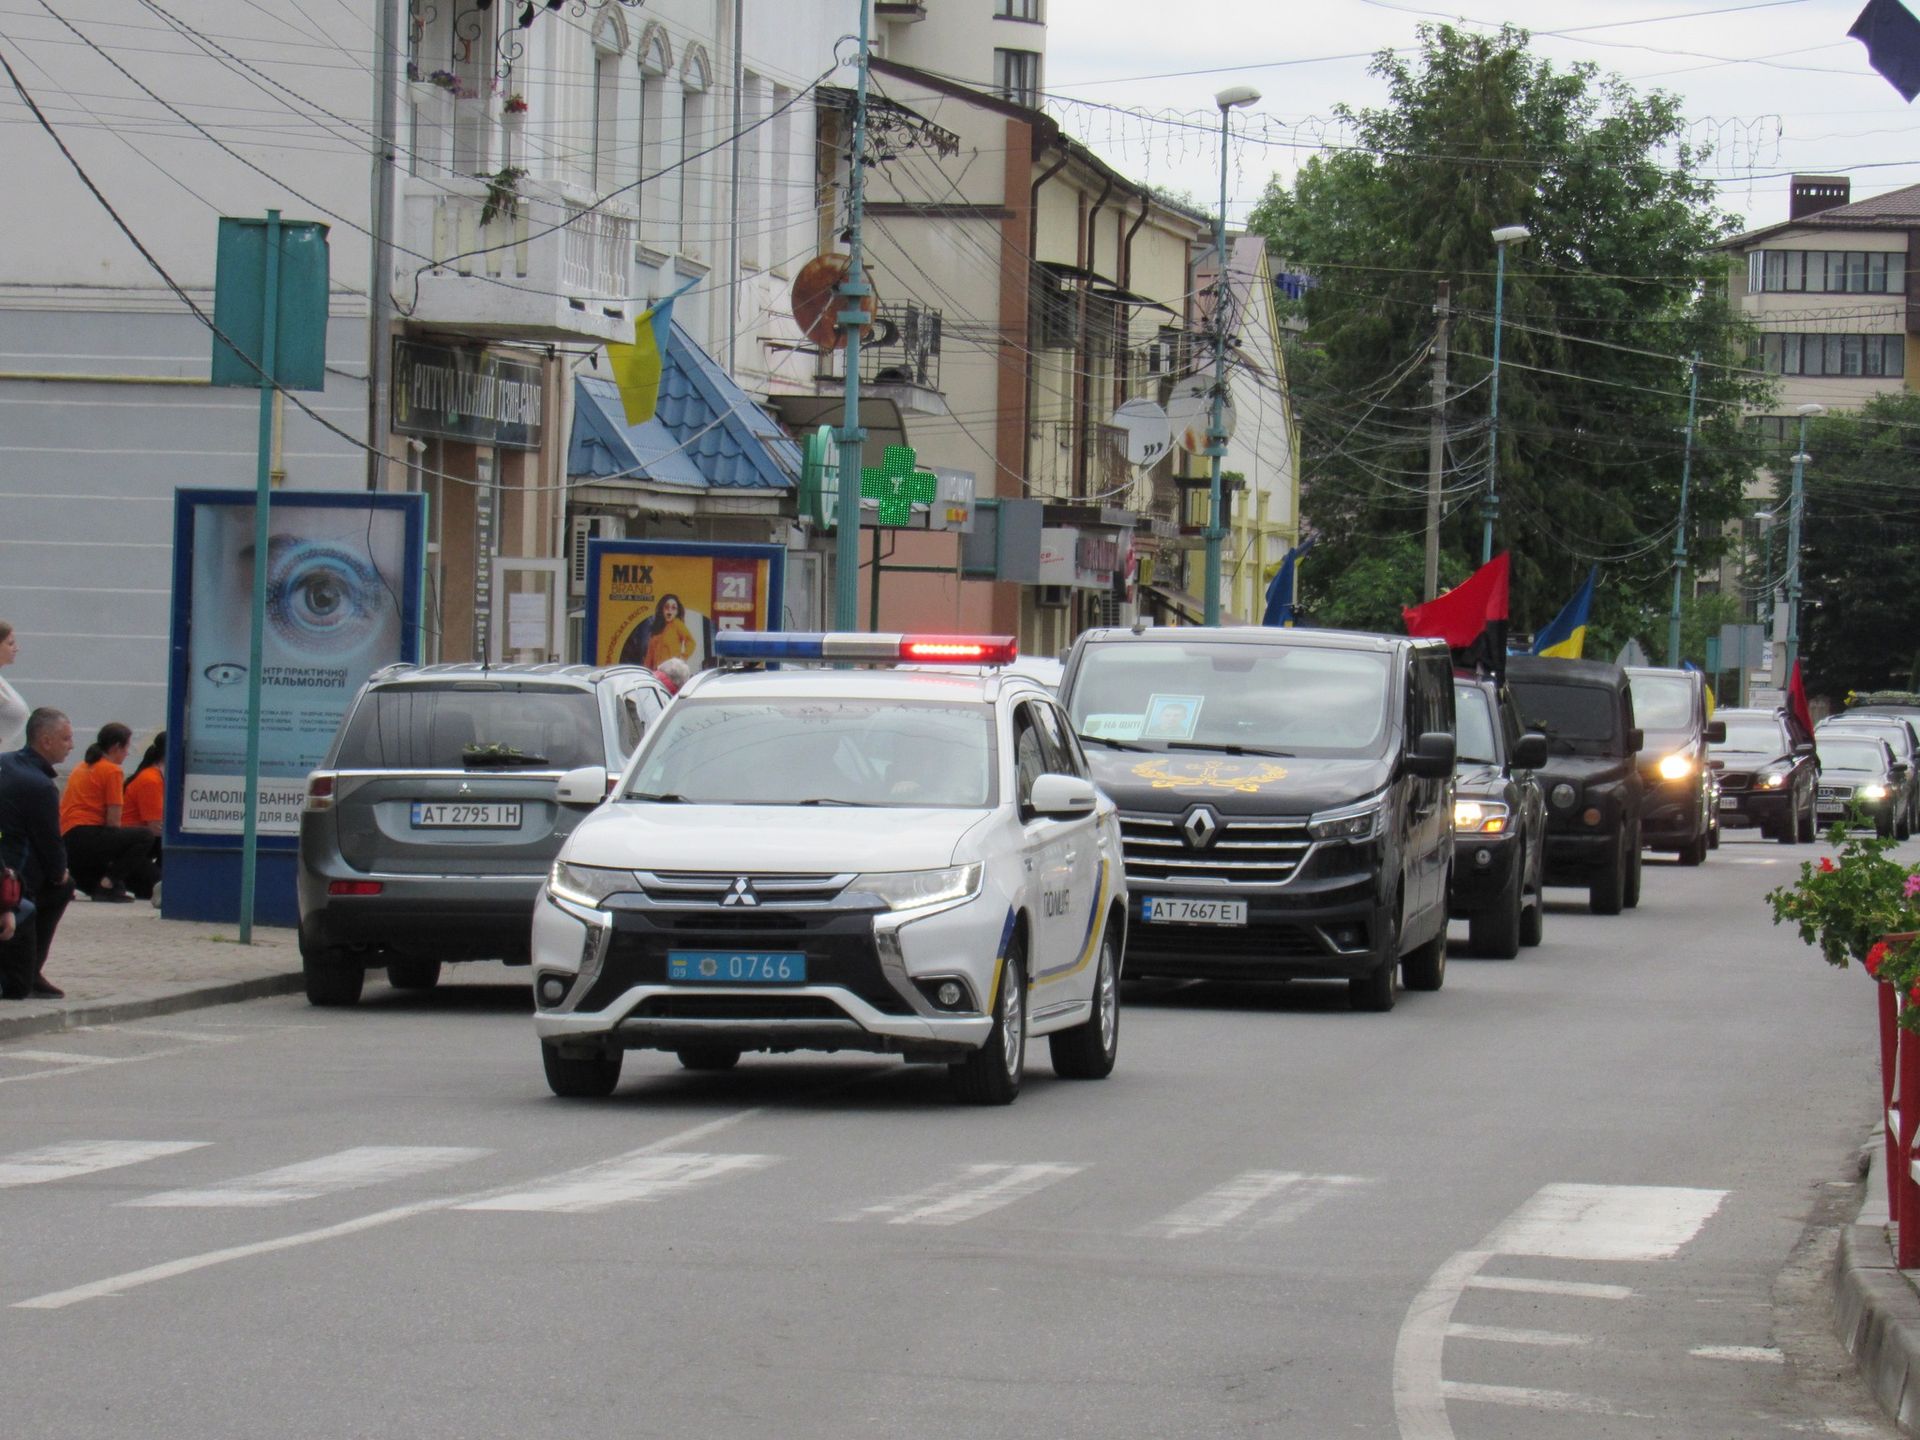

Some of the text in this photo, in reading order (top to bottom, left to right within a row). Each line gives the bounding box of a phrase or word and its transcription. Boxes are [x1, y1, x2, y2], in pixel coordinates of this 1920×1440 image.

[612, 564, 654, 584] MIX
[611, 583, 653, 595] BRAND
[722, 576, 746, 599] 21
[263, 666, 348, 678] НТР ПРАКТИЧНОЇ
[262, 676, 345, 689] ТАЛЬМОЛОГІЇ
[190, 789, 305, 806] САМОЛІВАННЯ
[259, 811, 282, 823] ДЛЯ
[285, 812, 300, 823] ВА
[423, 806, 447, 823] AT
[452, 806, 489, 823] 2795
[1153, 902, 1176, 918] AT
[1181, 903, 1217, 919] 7667
[672, 956, 791, 979] 09 0766
